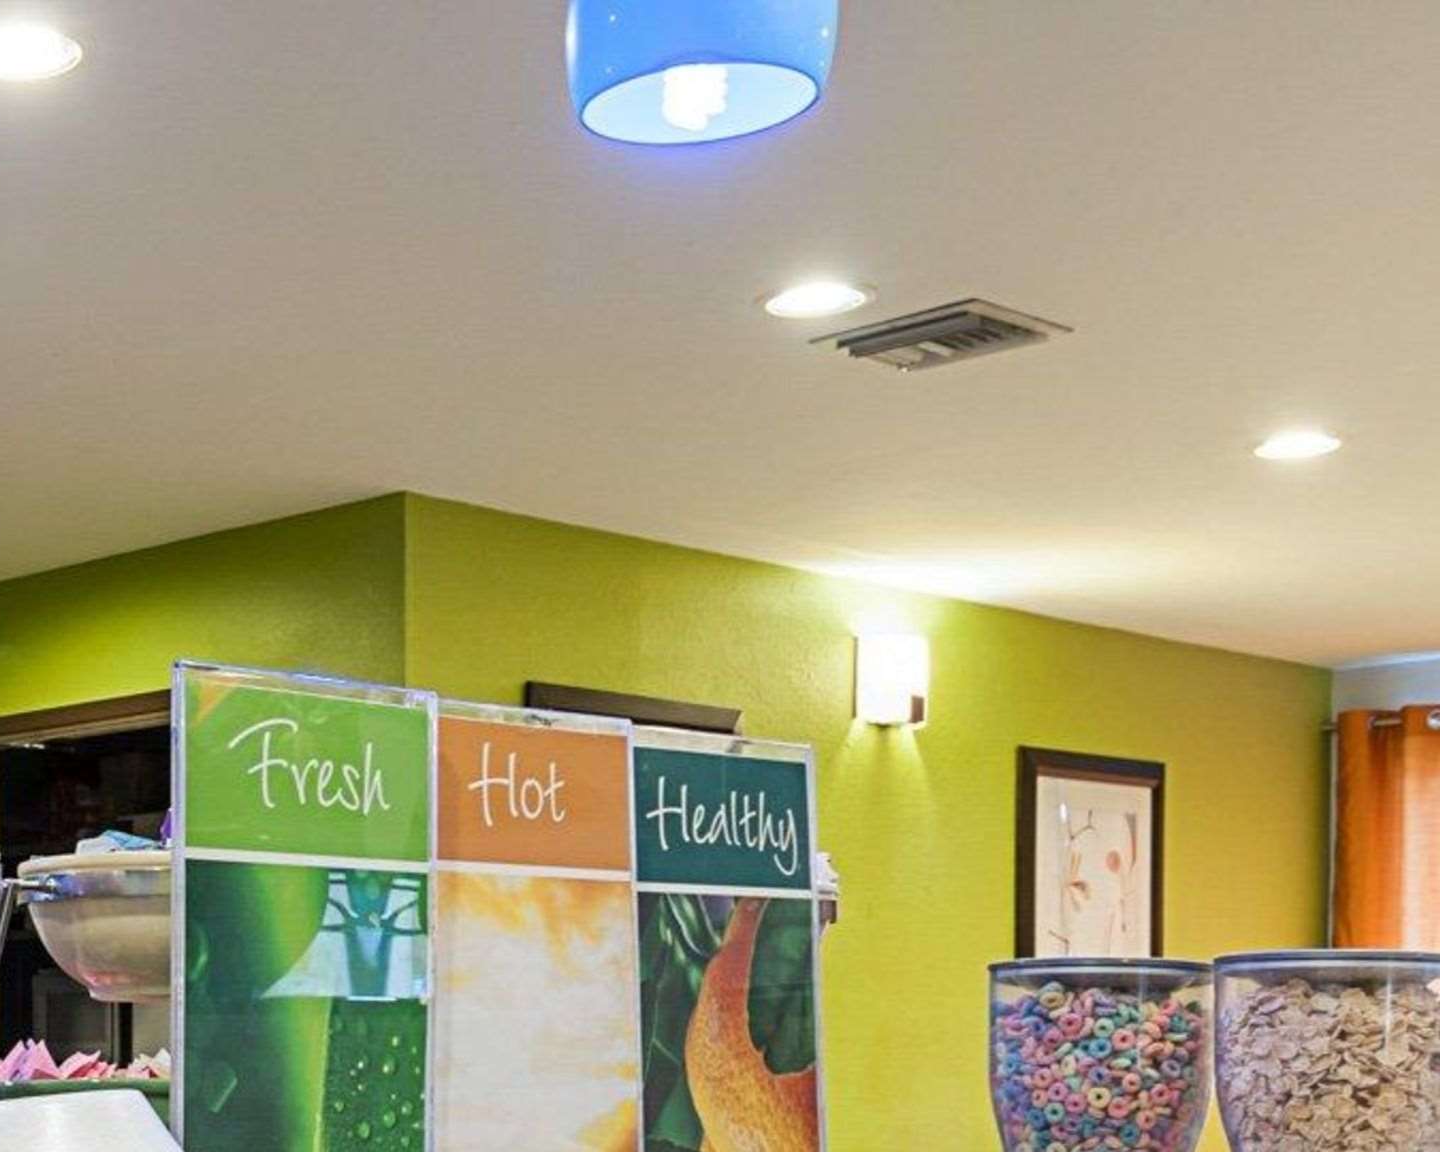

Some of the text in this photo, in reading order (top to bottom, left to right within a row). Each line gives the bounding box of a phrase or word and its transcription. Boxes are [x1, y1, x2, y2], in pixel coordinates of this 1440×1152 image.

[228, 717, 391, 817] Fresh
[468, 742, 565, 827] Hot
[646, 776, 797, 876] Healthy
